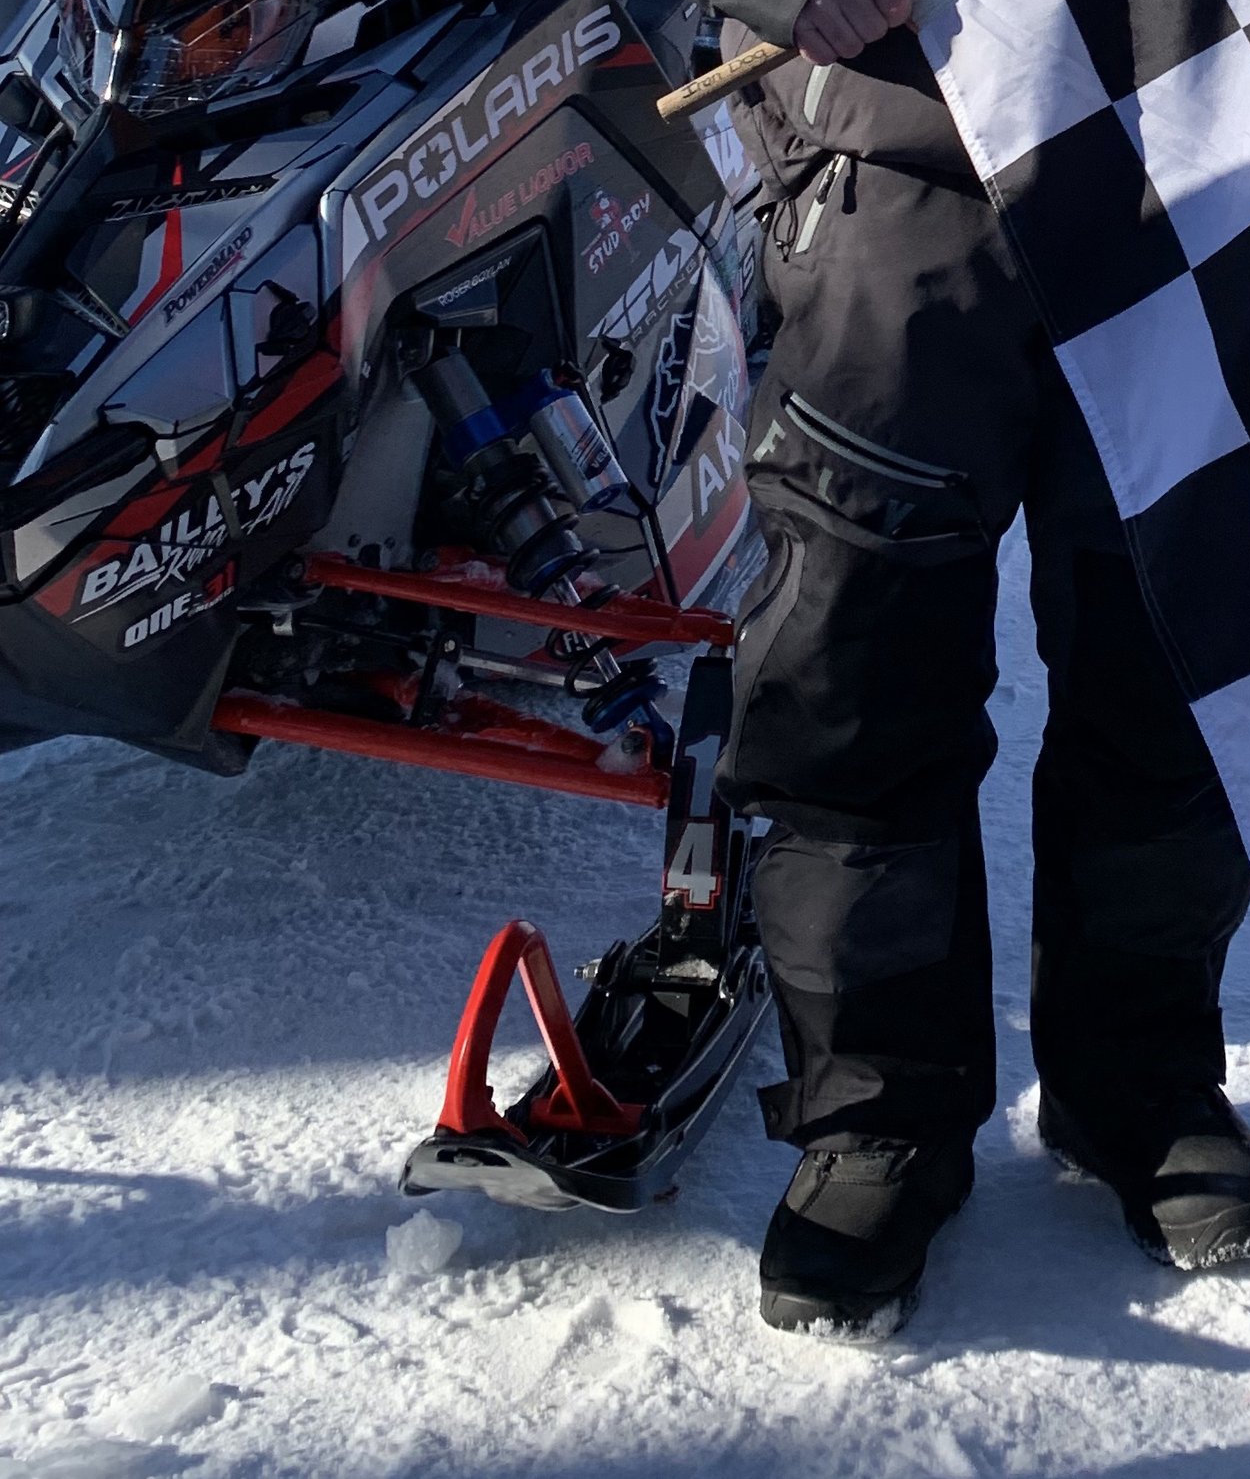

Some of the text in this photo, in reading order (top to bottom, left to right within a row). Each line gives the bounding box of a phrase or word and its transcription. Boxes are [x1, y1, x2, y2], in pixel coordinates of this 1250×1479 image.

[360, 4, 622, 242] POLARIS
[681, 72, 723, 99] Iron
[518, 141, 595, 206] LIQUOR
[588, 192, 651, 275] STUD BOY
[629, 257, 698, 344] RACING
[700, 428, 741, 516] AK
[80, 441, 316, 606] BAILEY'S
